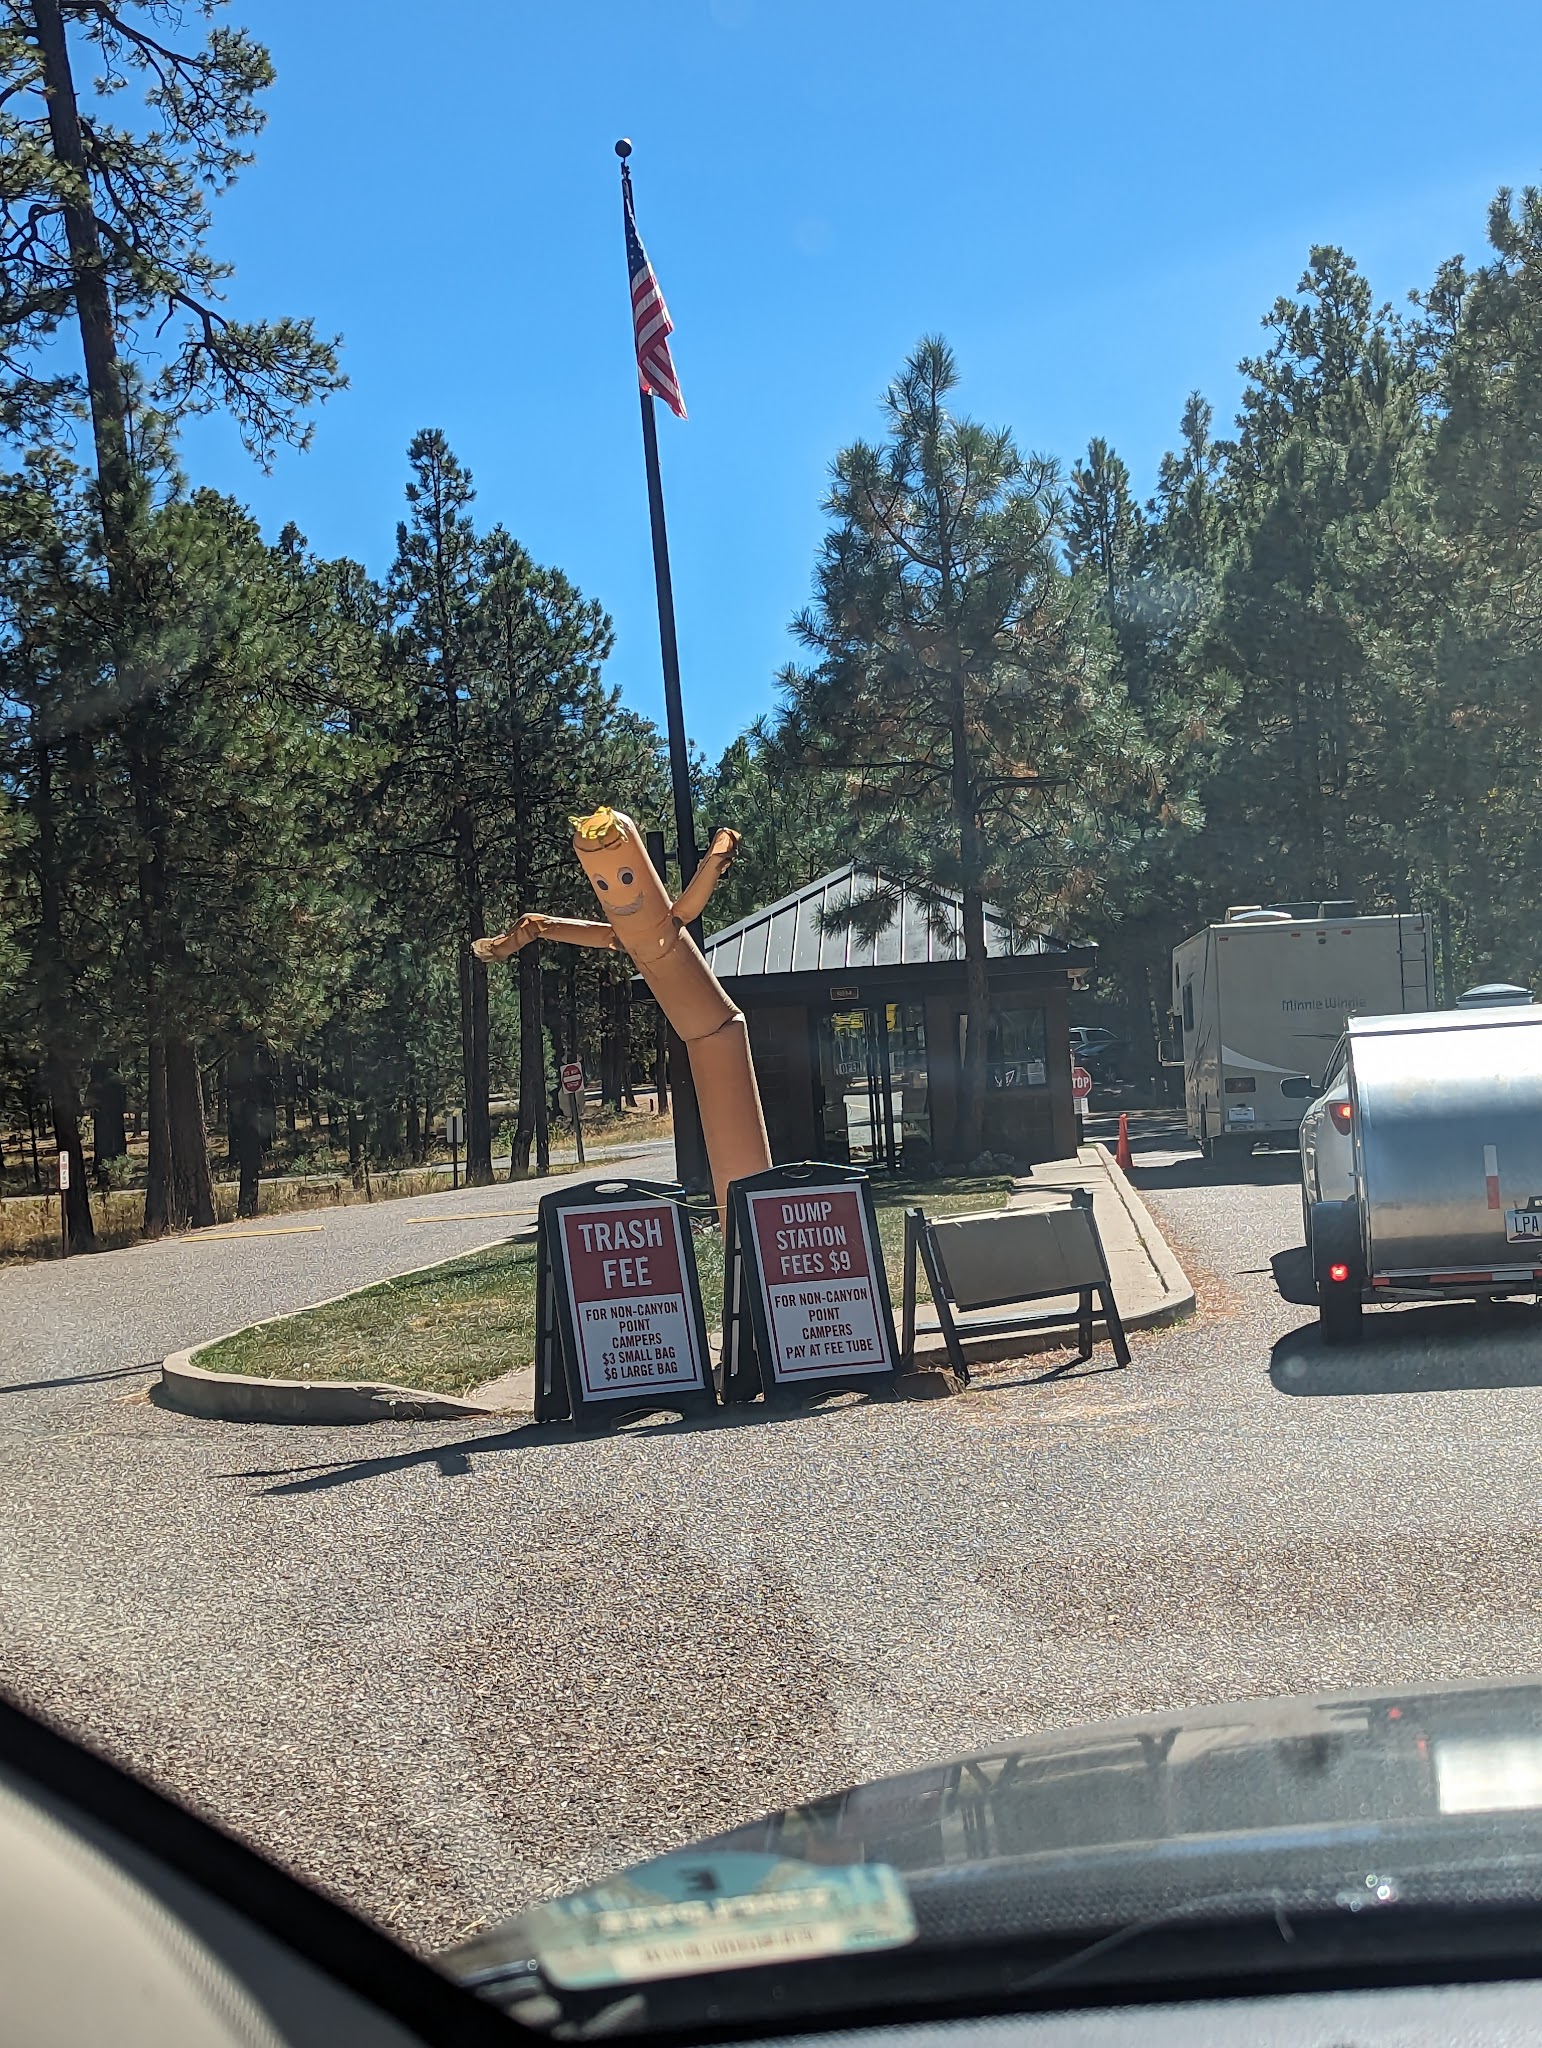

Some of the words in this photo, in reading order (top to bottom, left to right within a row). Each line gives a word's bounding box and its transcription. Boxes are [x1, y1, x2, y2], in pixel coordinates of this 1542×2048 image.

[1282, 999, 1323, 1011] Minnie
[1072, 1077, 1089, 1089] TOP
[781, 1201, 832, 1225] DUMP
[1514, 1215, 1540, 1234] LPA
[577, 1218, 663, 1253] TRASH
[775, 1225, 847, 1251] STATION
[602, 1255, 653, 1290] FEE
[780, 1252, 825, 1276] FEES
[828, 1249, 851, 1275] $9
[774, 1294, 797, 1309] FOR
[799, 1287, 868, 1306] NON-CANYON
[585, 1308, 608, 1322] FOR
[610, 1301, 679, 1320] NON-CANYON
[808, 1307, 840, 1322] POINT
[619, 1318, 650, 1334] POINT
[802, 1323, 853, 1340] CAMPERS
[612, 1332, 663, 1349] CAMPERS
[785, 1345, 806, 1359] PAY
[809, 1343, 821, 1357] AT
[824, 1341, 845, 1355] FEE
[845, 1338, 874, 1353] TUBE
[601, 1352, 616, 1367] $3
[618, 1348, 653, 1364] SMALL
[655, 1346, 676, 1360] BAG
[604, 1367, 618, 1382] $6
[620, 1363, 655, 1379] LARGE
[657, 1361, 678, 1376] BAG
